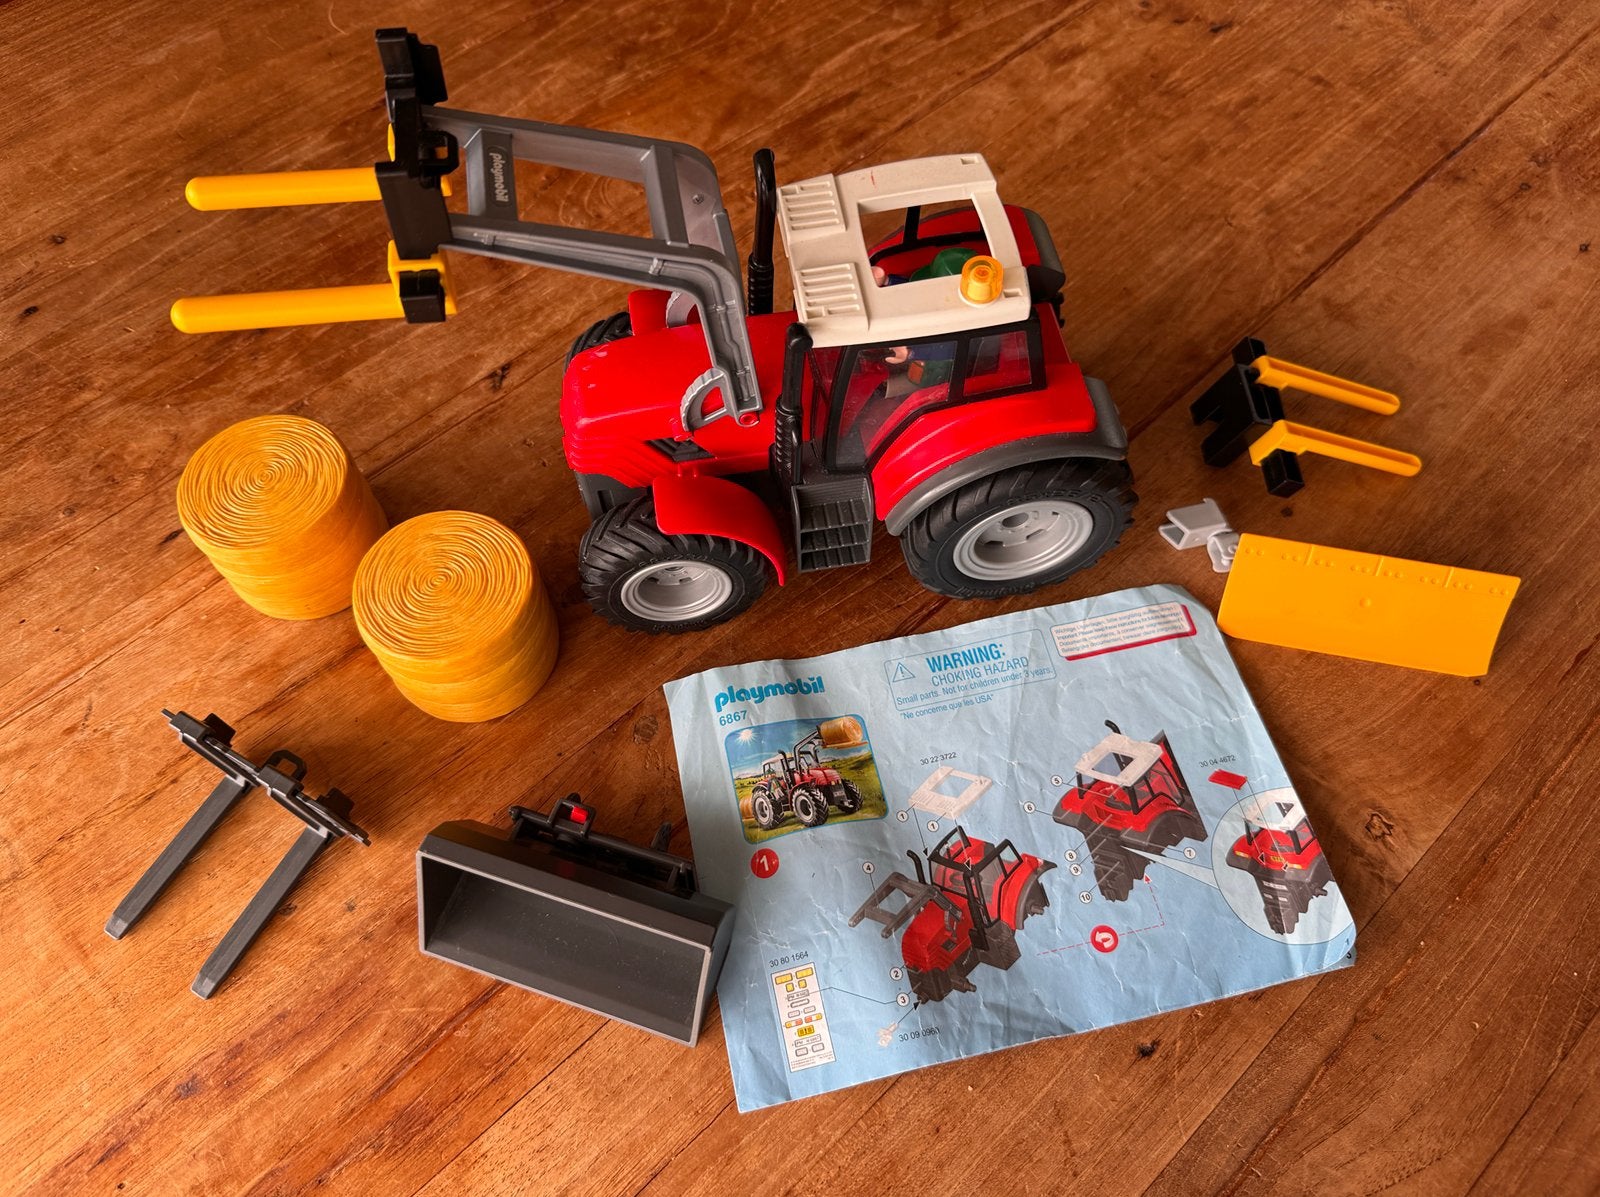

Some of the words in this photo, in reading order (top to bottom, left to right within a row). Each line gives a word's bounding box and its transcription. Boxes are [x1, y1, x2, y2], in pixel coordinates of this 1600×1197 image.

[488, 152, 509, 202] playmobil
[926, 643, 1006, 673] WARNING:
[931, 667, 982, 687] CHOKING
[984, 656, 1029, 676] HAZARD
[714, 675, 825, 712] playmobil
[896, 691, 919, 705] Small
[920, 689, 940, 702] parts.
[942, 686, 957, 696] Not
[958, 683, 969, 693] for
[969, 677, 1000, 690] children
[1001, 672, 1023, 684] under
[1024, 670, 1030, 679] 3
[1030, 666, 1053, 678] years.
[949, 701, 963, 711] que
[963, 698, 975, 707] les
[719, 709, 748, 726] 6867
[919, 758, 930, 766] 30
[930, 755, 939, 763] 22
[940, 751, 957, 761] 3722
[1199, 760, 1208, 768] 30
[1209, 758, 1218, 766] 04
[759, 855, 769, 872] 1
[1081, 893, 1091, 901] 10
[769, 958, 779, 968] 30
[780, 955, 790, 965] 80
[791, 950, 809, 962] 1564
[898, 1032, 909, 1042] 30
[910, 1030, 920, 1040] 09
